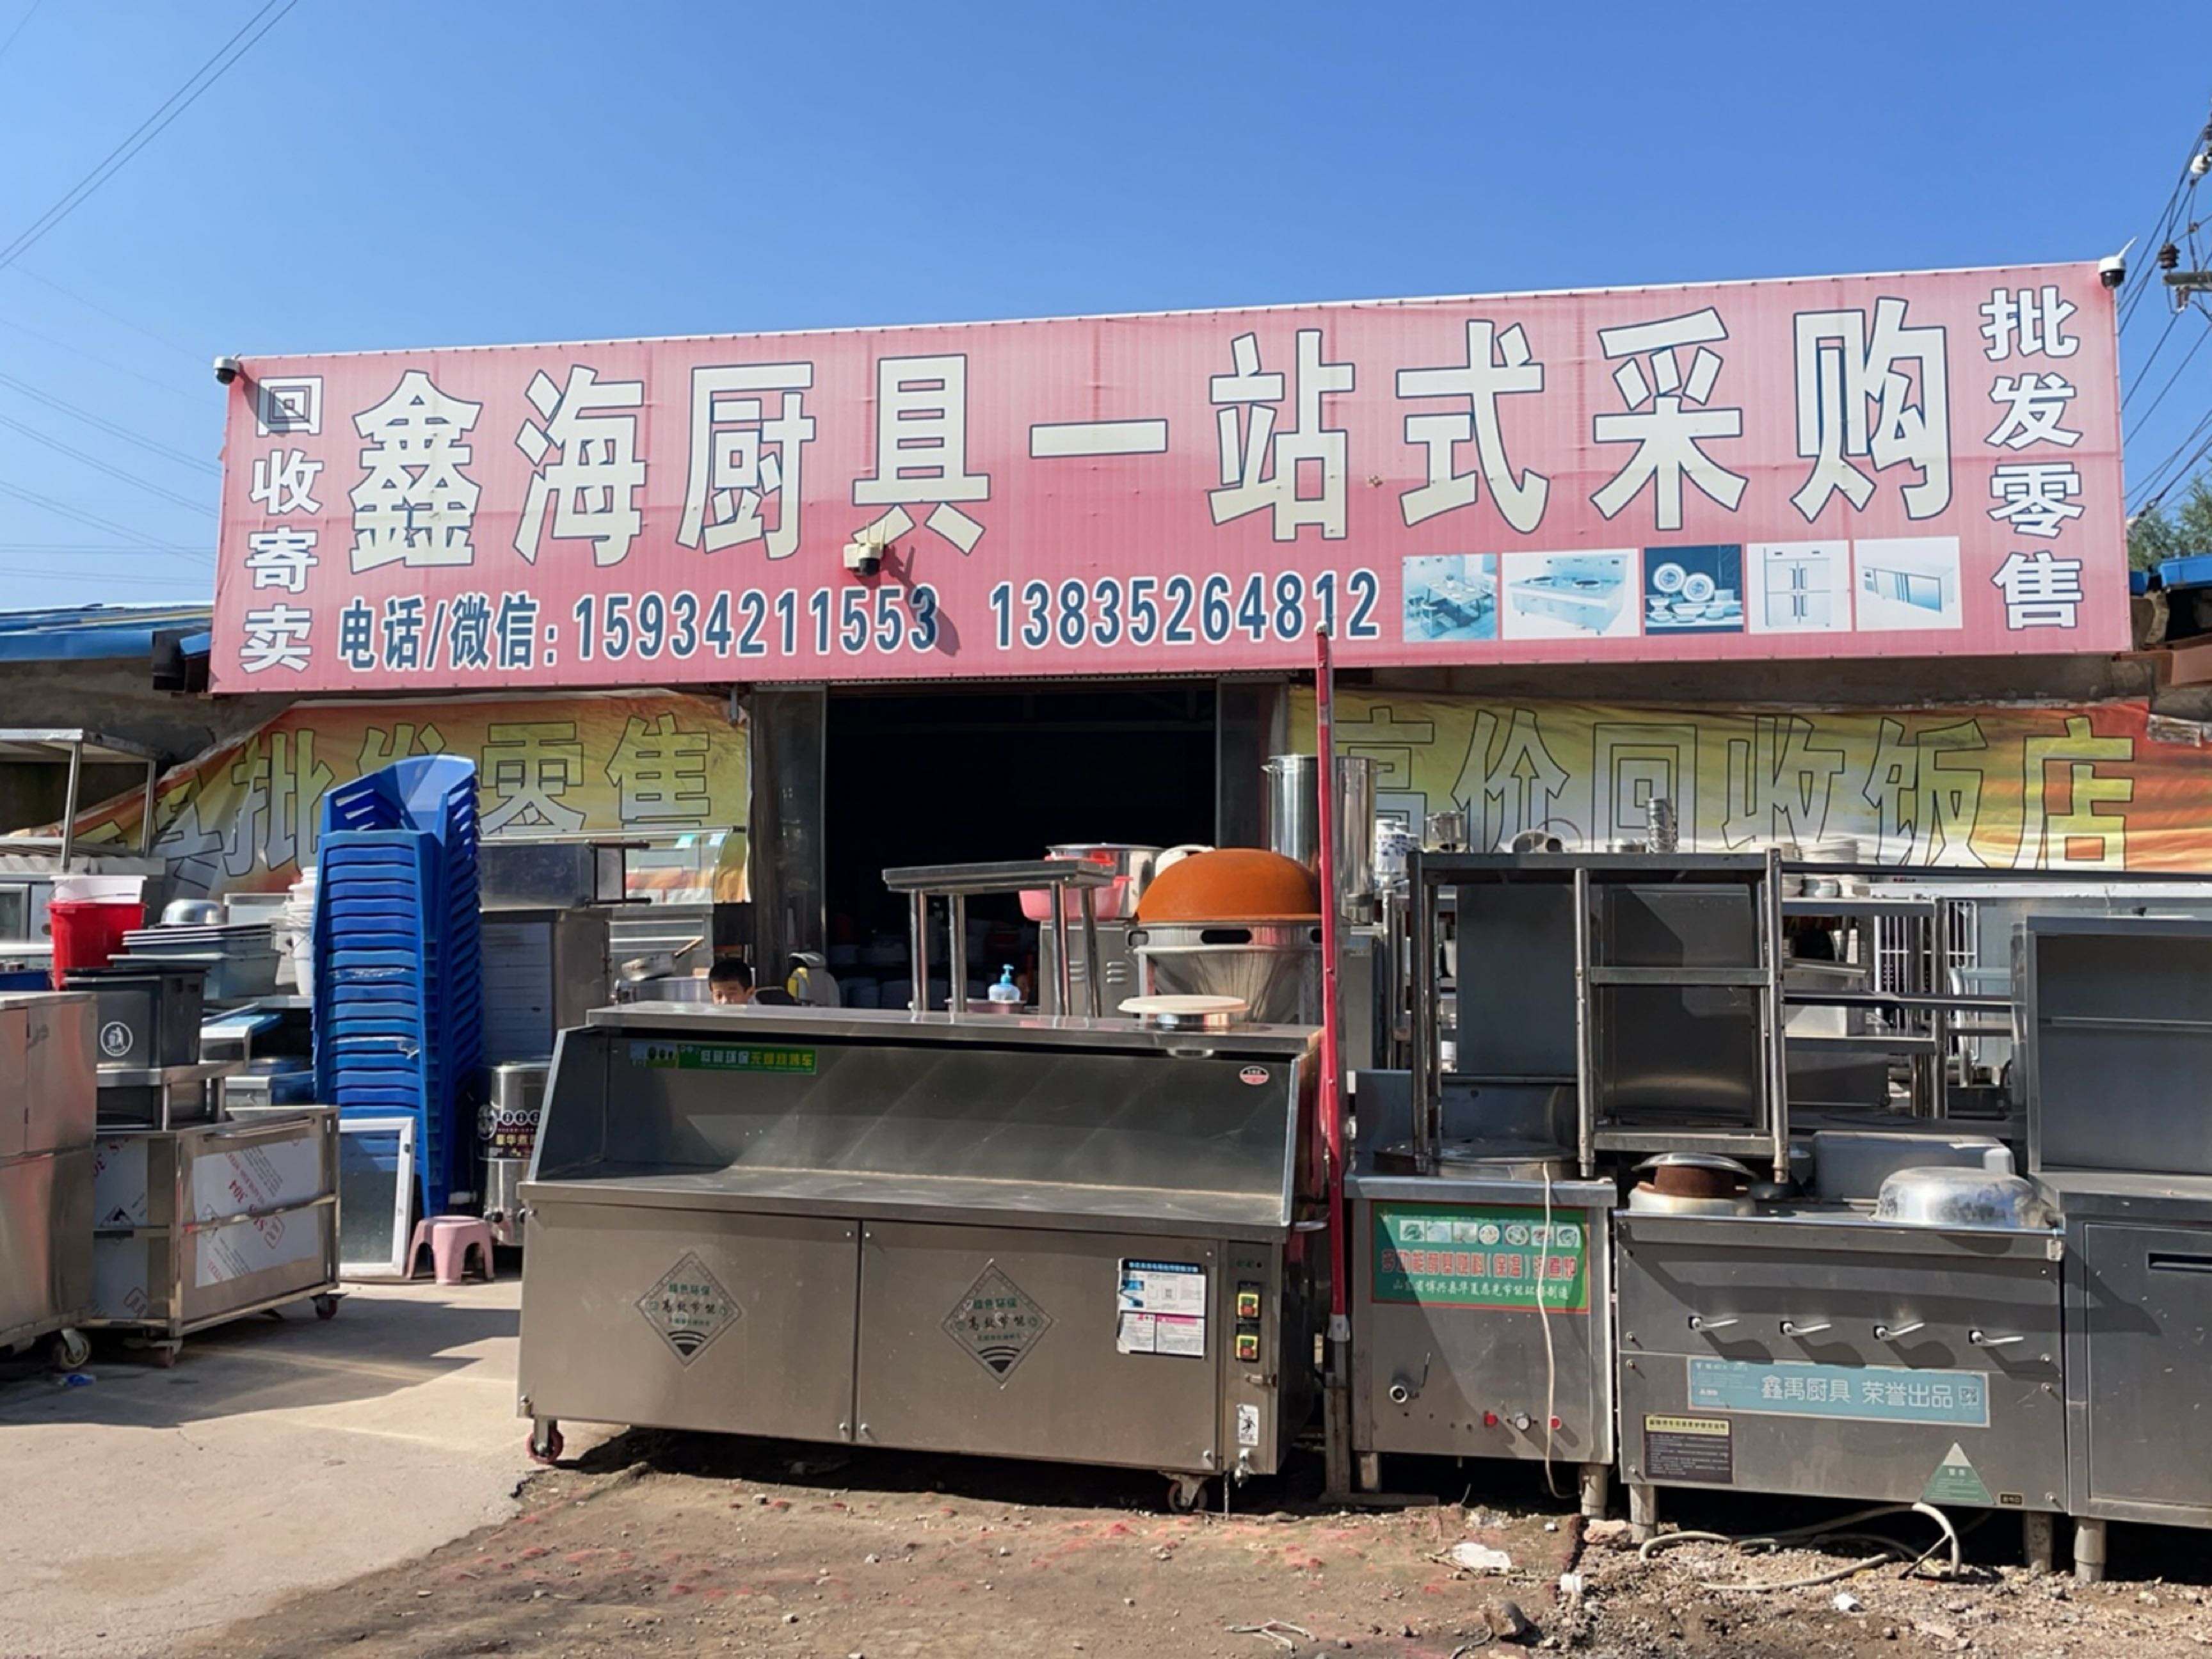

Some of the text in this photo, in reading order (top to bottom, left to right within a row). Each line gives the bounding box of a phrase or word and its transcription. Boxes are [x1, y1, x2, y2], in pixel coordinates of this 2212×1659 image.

[239, 375, 325, 674] 回收寄卖
[349, 296, 1953, 574] 鑫海厨具一站式采购
[1980, 285, 2085, 630] 批发零售
[990, 567, 1381, 650] 13835264812
[1761, 1374, 1852, 1404] 鑫禹厨具
[1861, 1379, 1954, 1409] 荣誉出品
